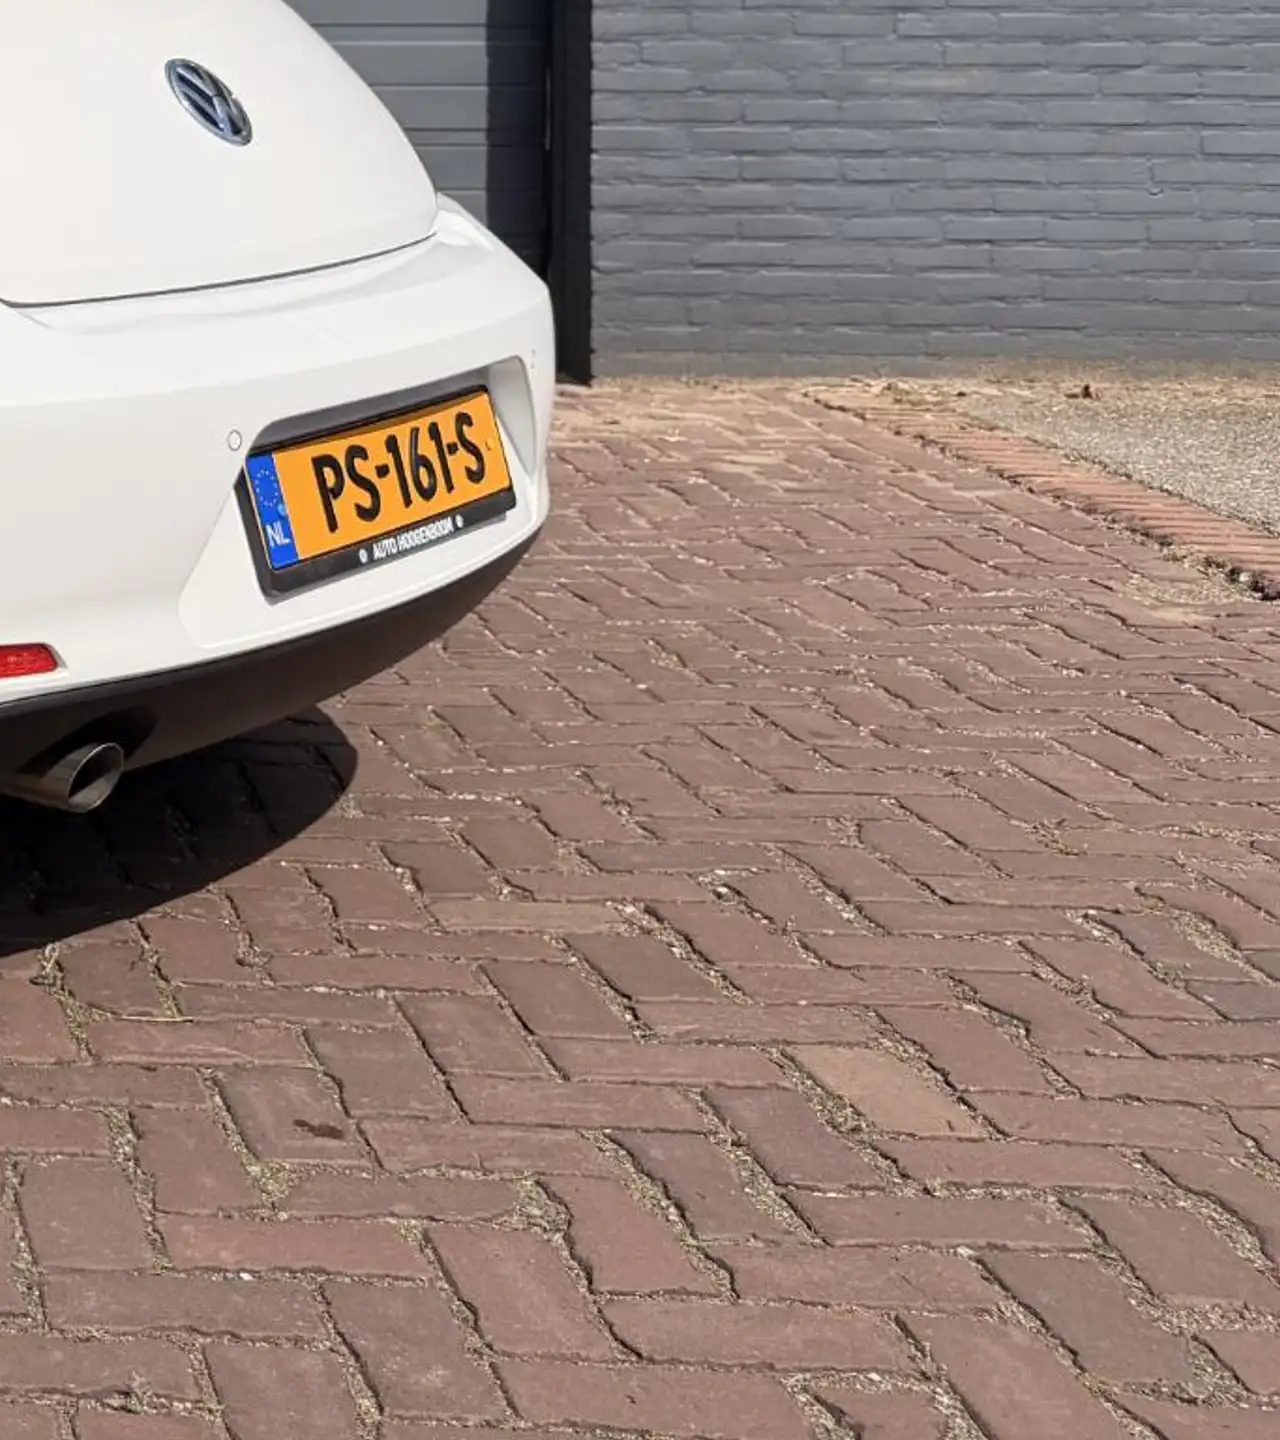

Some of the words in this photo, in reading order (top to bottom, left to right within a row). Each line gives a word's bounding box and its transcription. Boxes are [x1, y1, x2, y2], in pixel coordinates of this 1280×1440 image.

[311, 412, 486, 533] PS-161-S
[265, 520, 291, 549] NL
[372, 537, 398, 561] AUTO
